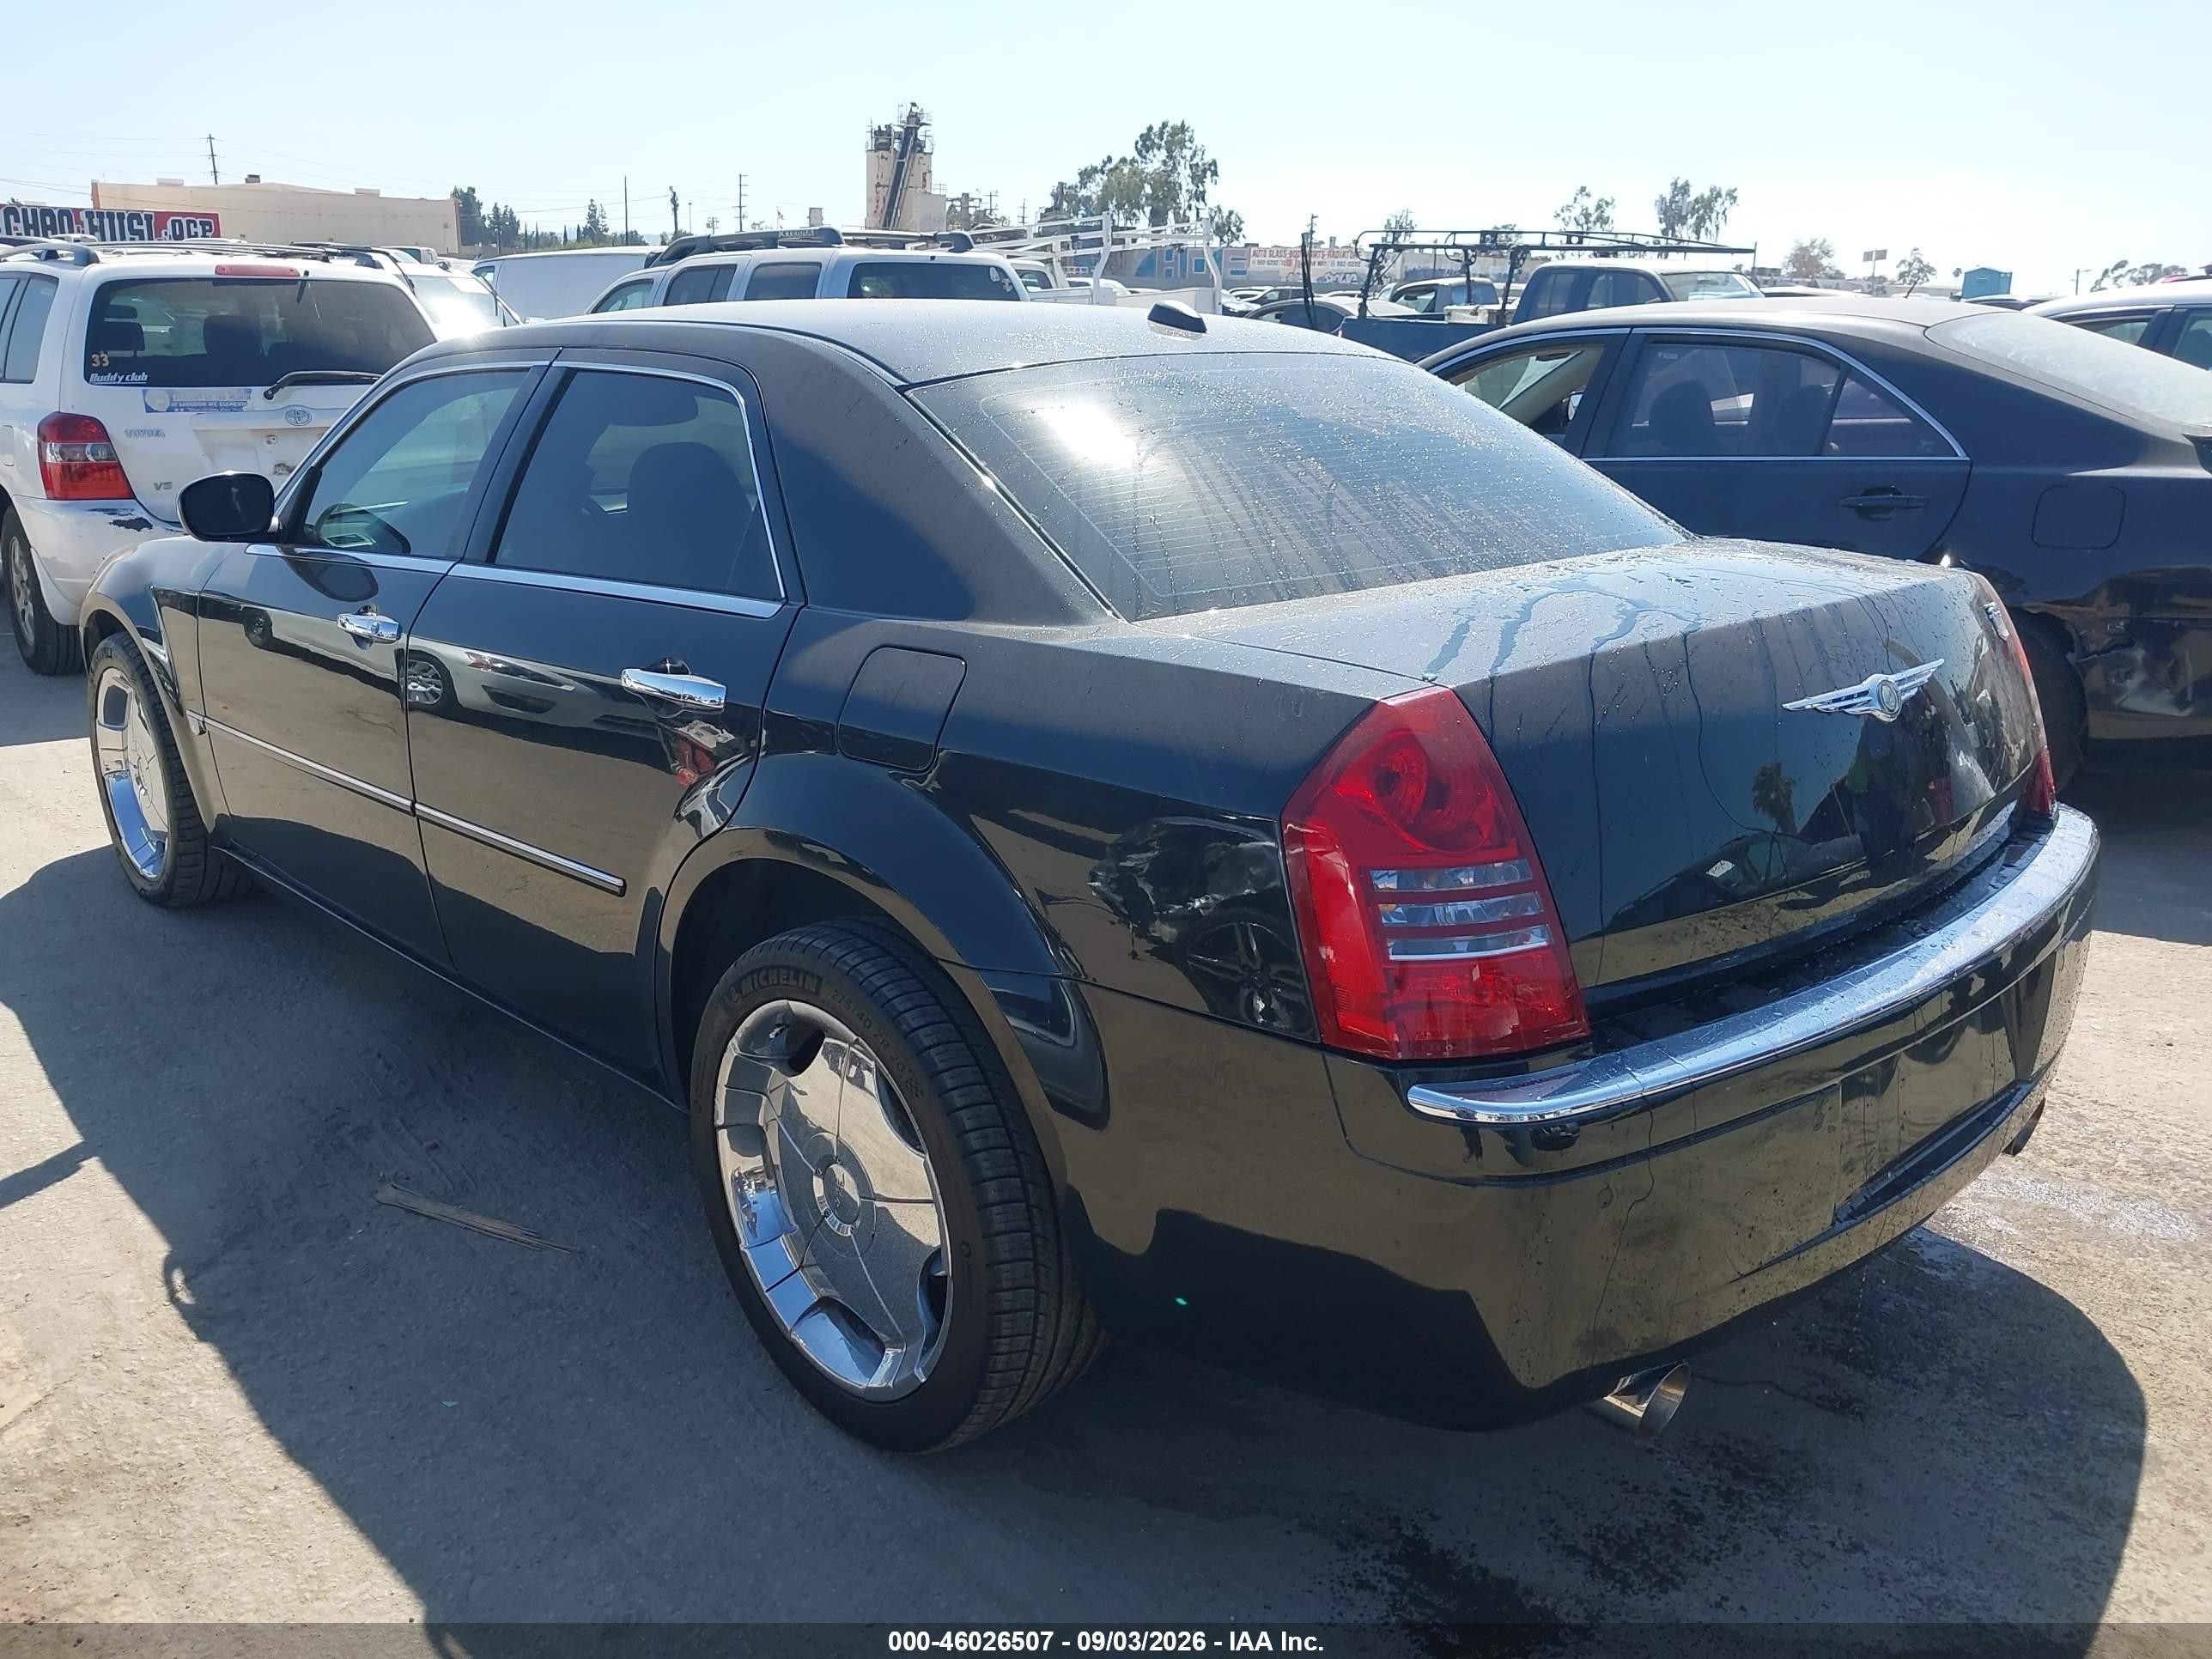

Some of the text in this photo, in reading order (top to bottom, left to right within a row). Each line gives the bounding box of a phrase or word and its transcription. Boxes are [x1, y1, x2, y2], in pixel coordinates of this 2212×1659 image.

[91, 353, 110, 367] 33
[125, 372, 148, 381] club
[740, 969, 820, 996] MICHELIN
